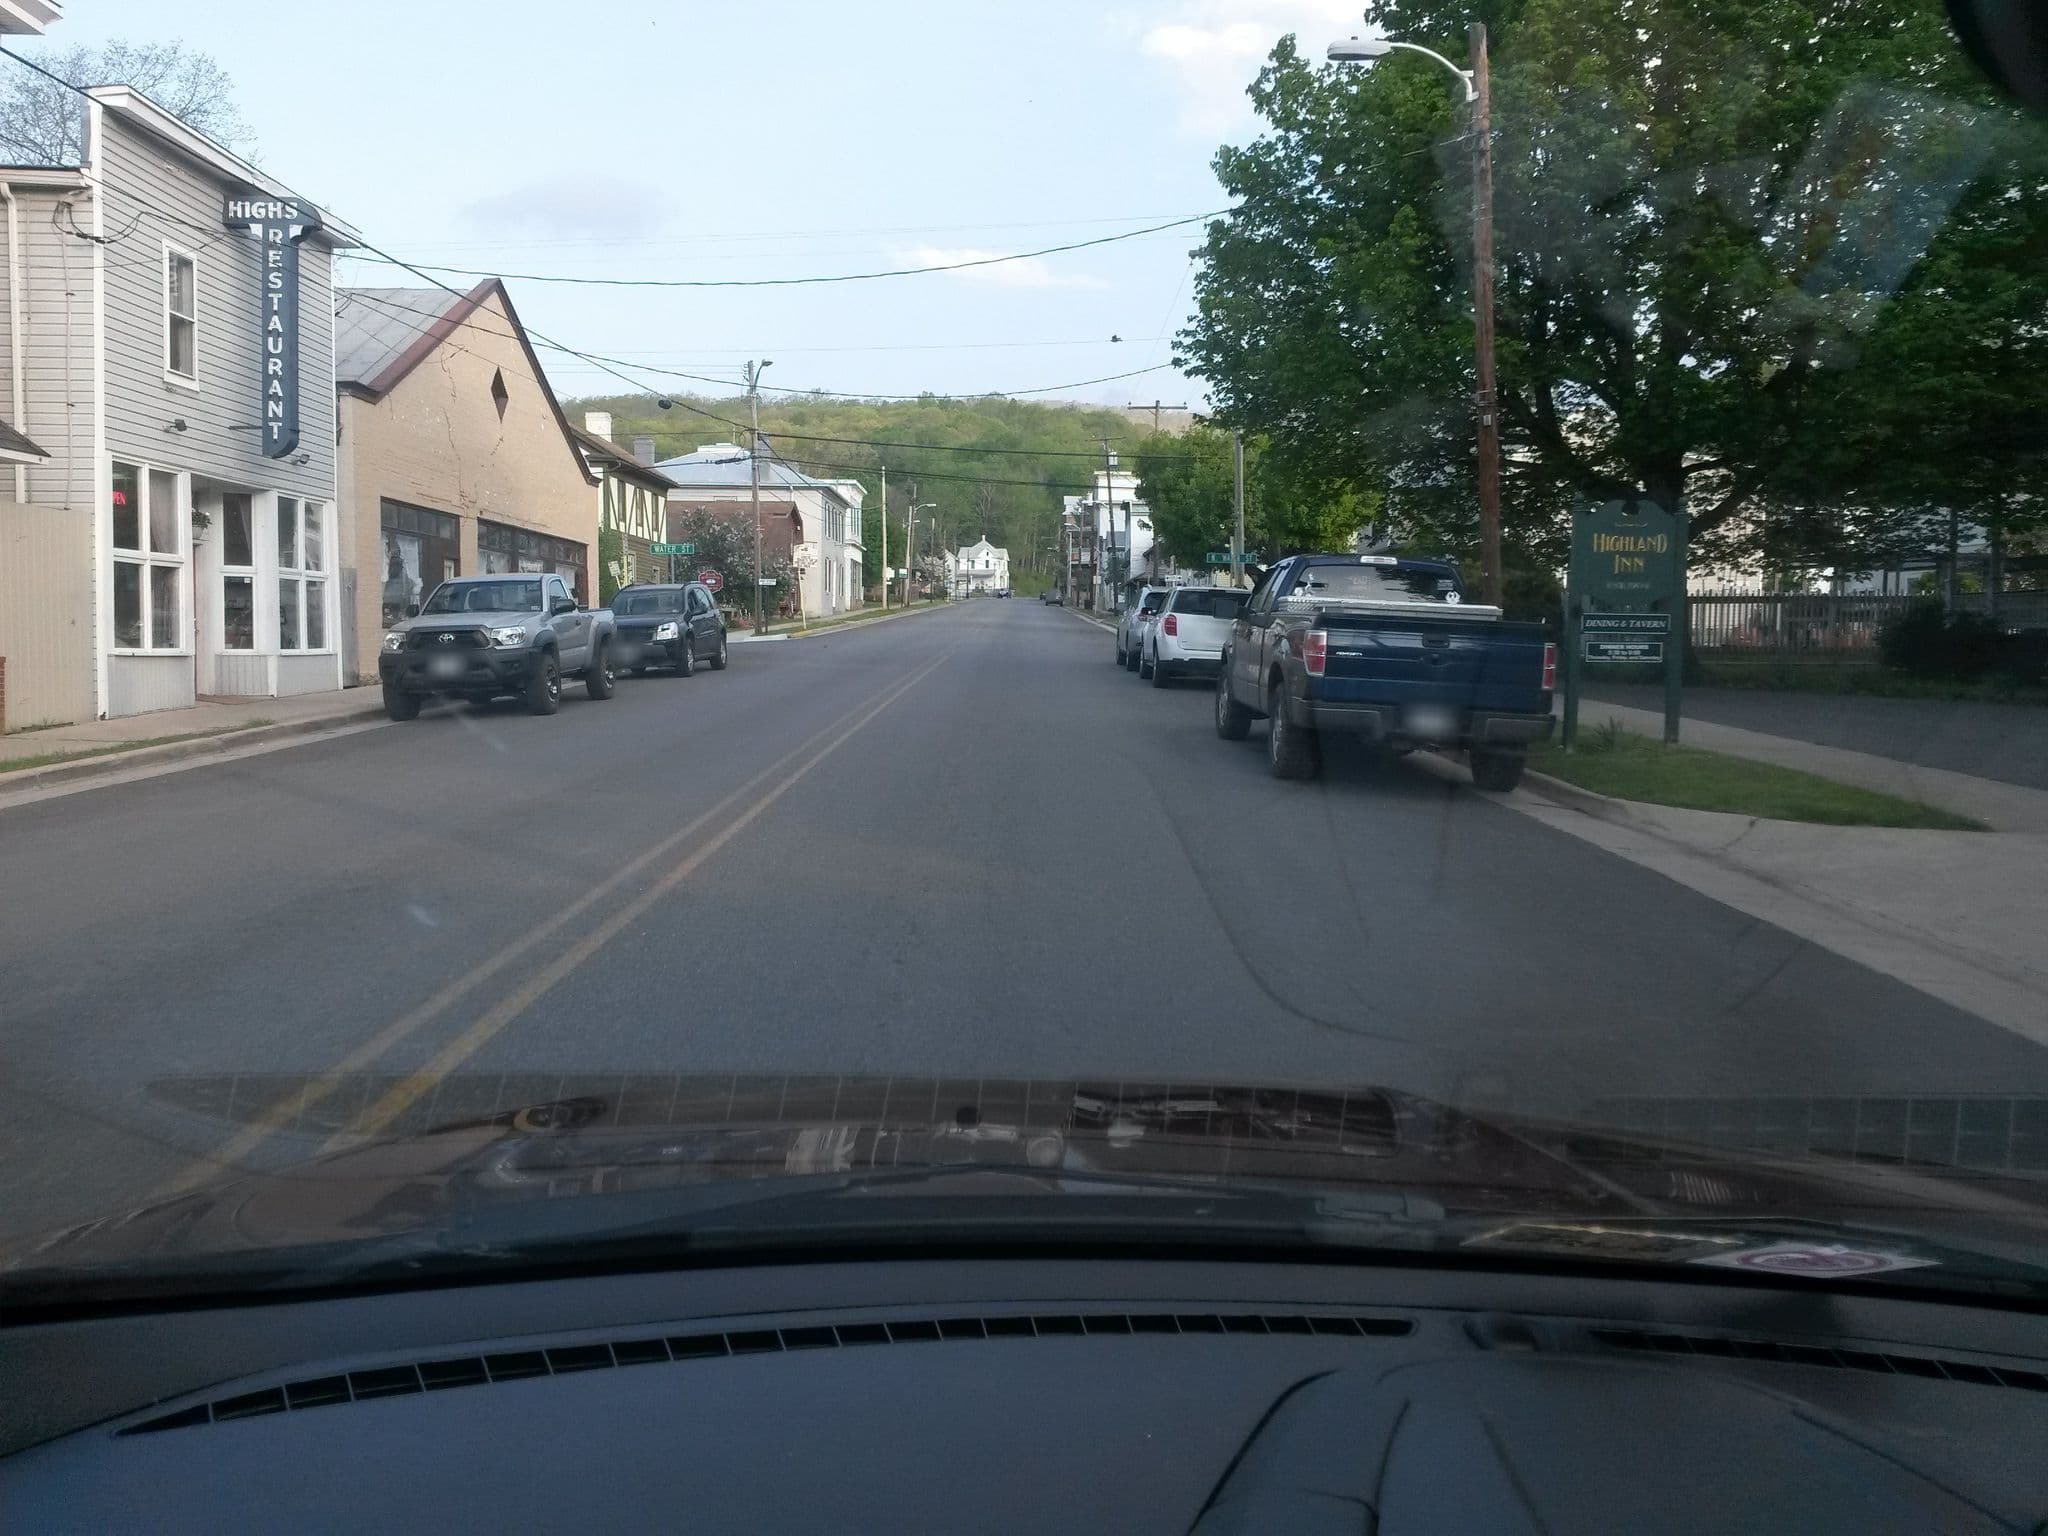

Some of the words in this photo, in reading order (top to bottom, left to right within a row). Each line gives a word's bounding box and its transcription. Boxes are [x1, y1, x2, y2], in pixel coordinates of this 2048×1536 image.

[267, 228, 284, 440] RESTAURANT
[1593, 533, 1668, 554] HIGHLAND
[1614, 554, 1645, 575] INN
[1585, 619, 1620, 627] DINING
[1629, 620, 1666, 628] TAVERN
